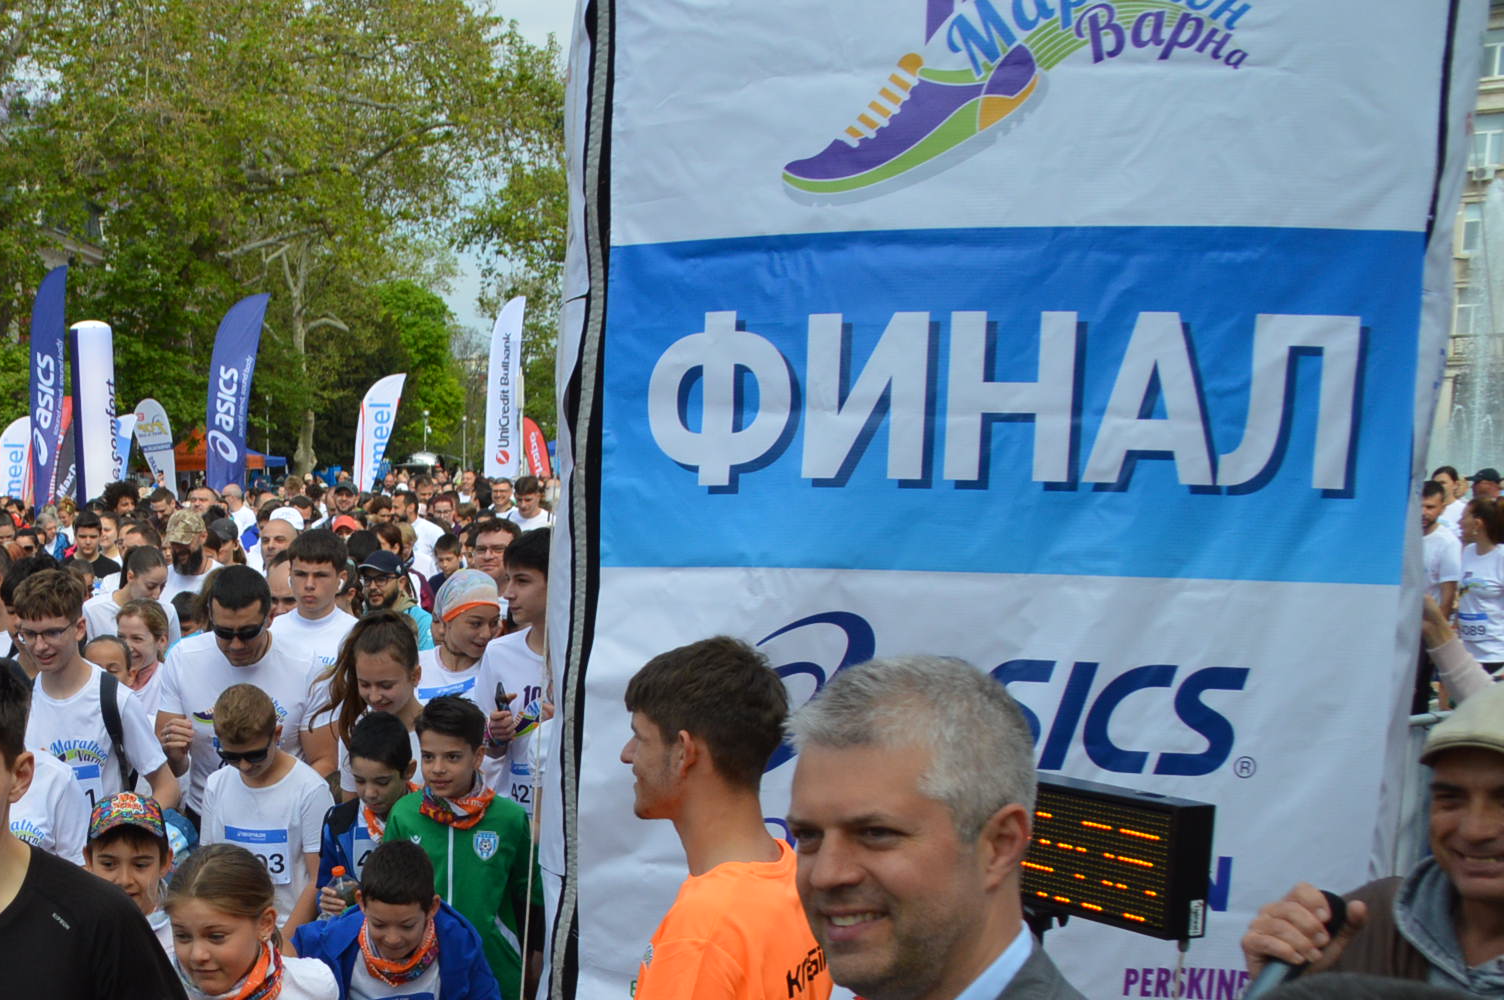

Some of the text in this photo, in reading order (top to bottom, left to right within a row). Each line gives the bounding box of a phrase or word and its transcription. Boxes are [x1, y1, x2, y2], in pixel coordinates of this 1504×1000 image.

[1075, 3, 1249, 70] Варна
[36, 352, 55, 430] asics
[215, 365, 239, 432] asics
[498, 332, 512, 447] UniCredit Bulbank
[648, 310, 1366, 492] ФИНАЛ
[1461, 624, 1487, 636] 089
[50, 739, 109, 761] Marathon
[991, 658, 1252, 777] SICS
[511, 782, 535, 803] 42
[10, 818, 45, 841] athon
